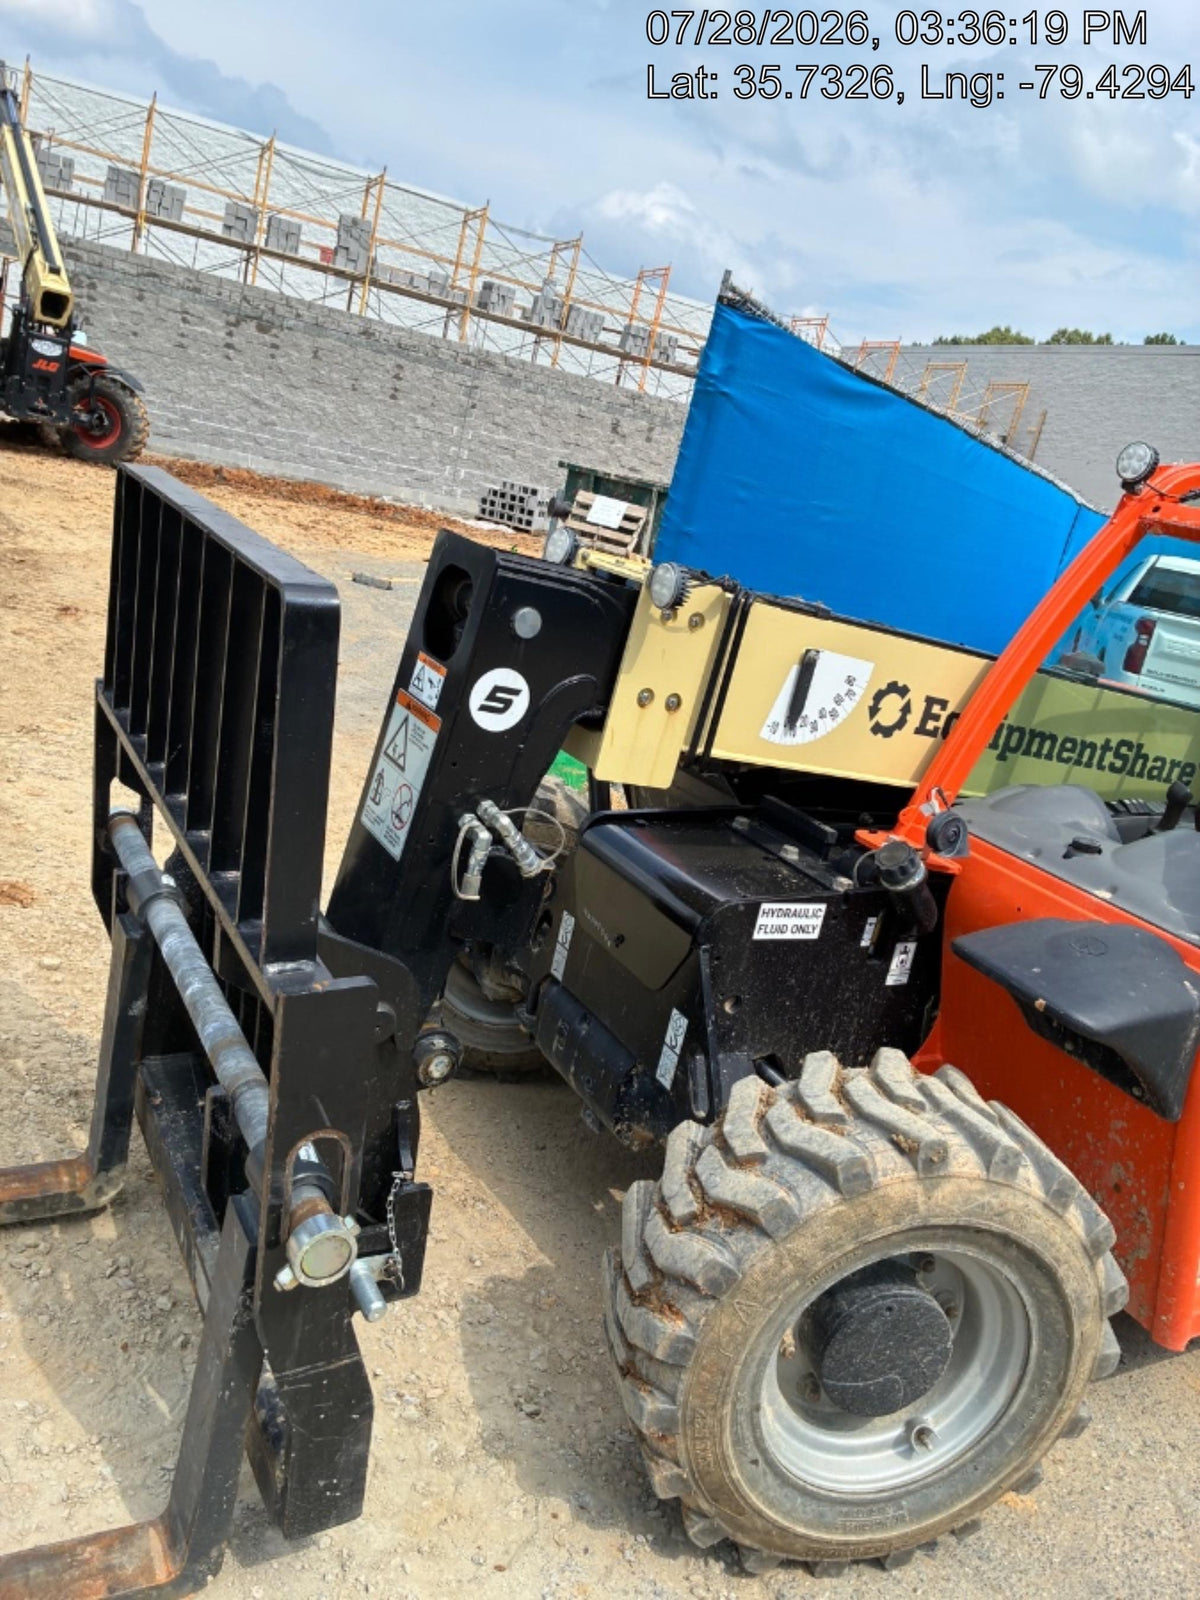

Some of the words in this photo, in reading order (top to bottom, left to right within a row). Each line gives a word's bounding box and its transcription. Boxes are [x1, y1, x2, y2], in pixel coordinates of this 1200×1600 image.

[32, 358, 60, 373] JLG
[913, 694, 1196, 787] EipmentShare
[761, 908, 823, 919] HYDRAULIC
[757, 924, 788, 935] FLUID
[790, 924, 818, 935] ONLY
